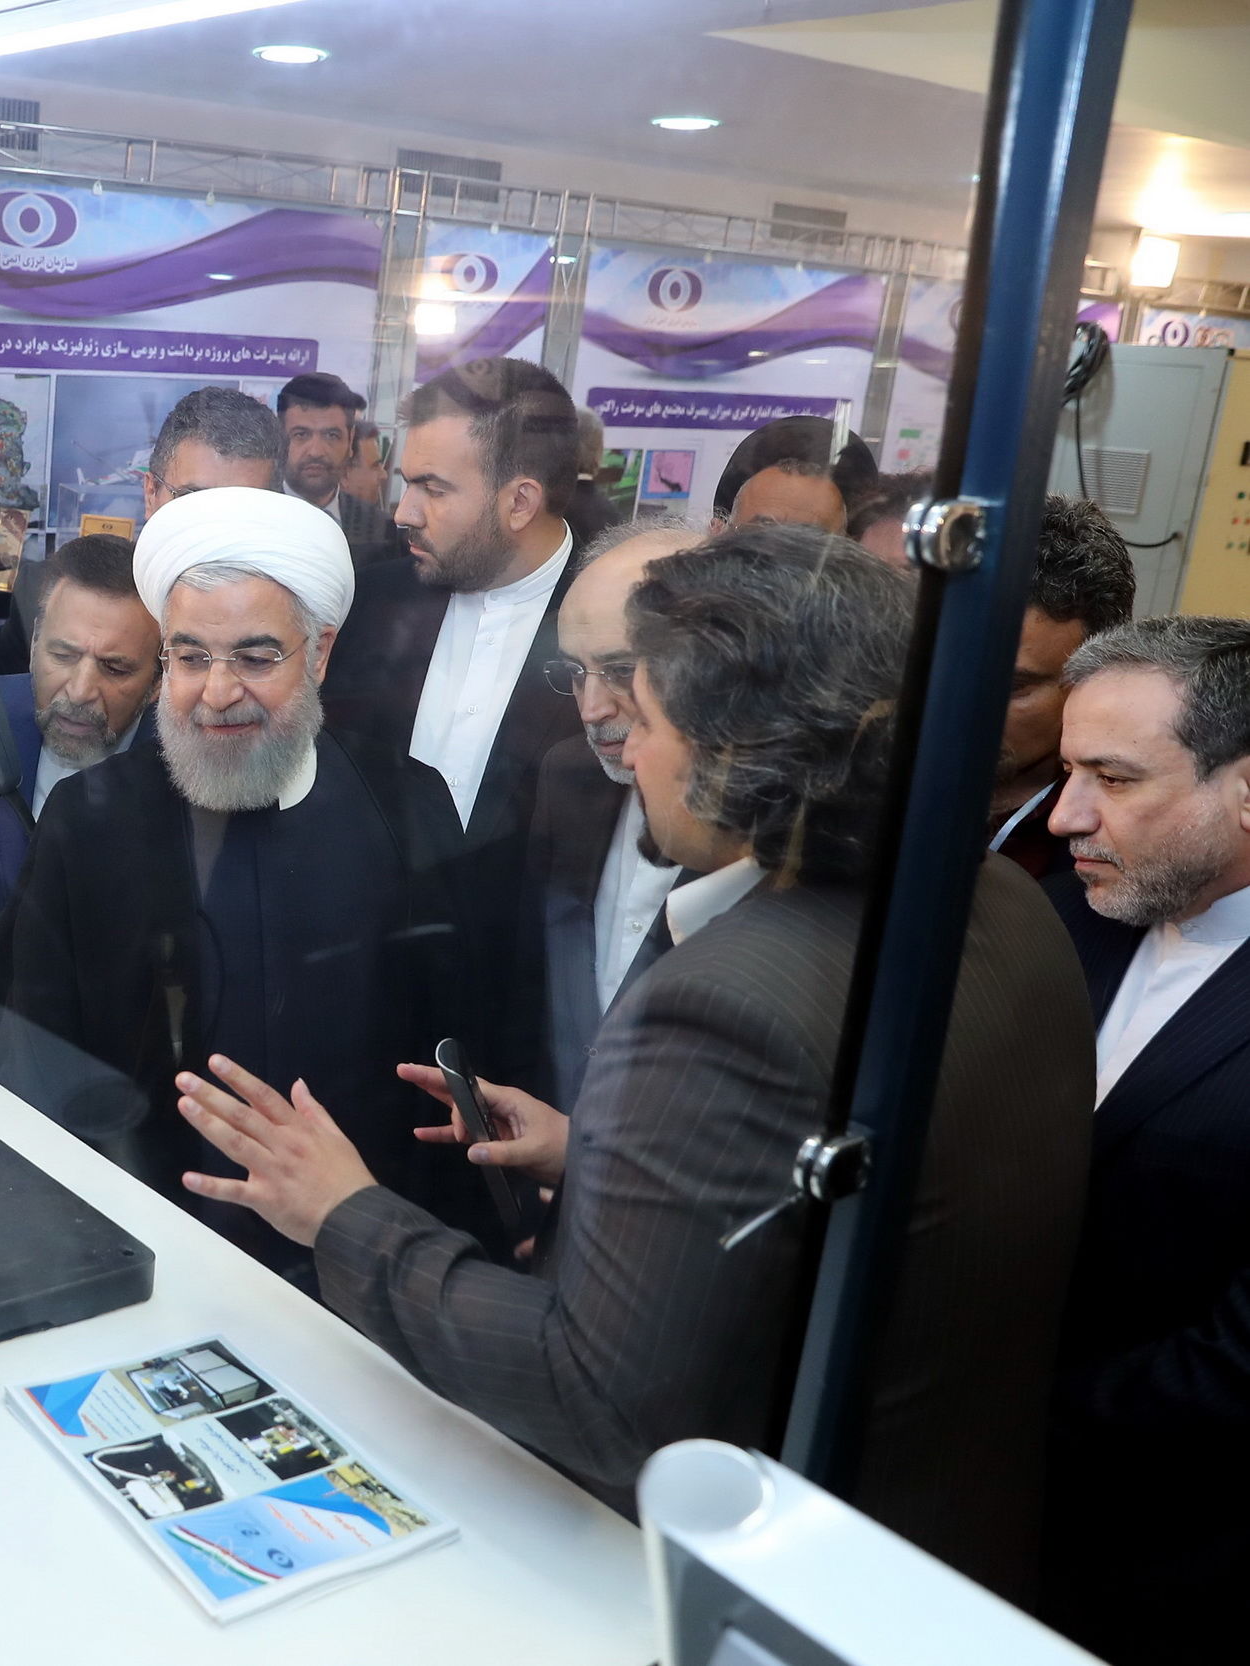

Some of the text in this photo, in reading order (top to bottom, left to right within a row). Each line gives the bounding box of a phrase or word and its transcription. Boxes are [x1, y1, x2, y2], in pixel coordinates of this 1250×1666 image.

[23, 256, 44, 267] انرژی
[46, 257, 74, 269] سازمان
[0, 340, 12, 354] در
[15, 336, 49, 355] هوابرد
[52, 338, 99, 356] ژئوفیزیک
[101, 340, 129, 358] سازی
[131, 346, 158, 360] بومی
[168, 344, 204, 360] برداشت
[159, 348, 164, 360] و
[205, 346, 230, 362] پروژه
[232, 346, 252, 362] های
[254, 347, 286, 364] پیشرفت
[288, 349, 310, 366] ارائه
[620, 400, 645, 418] سوخت
